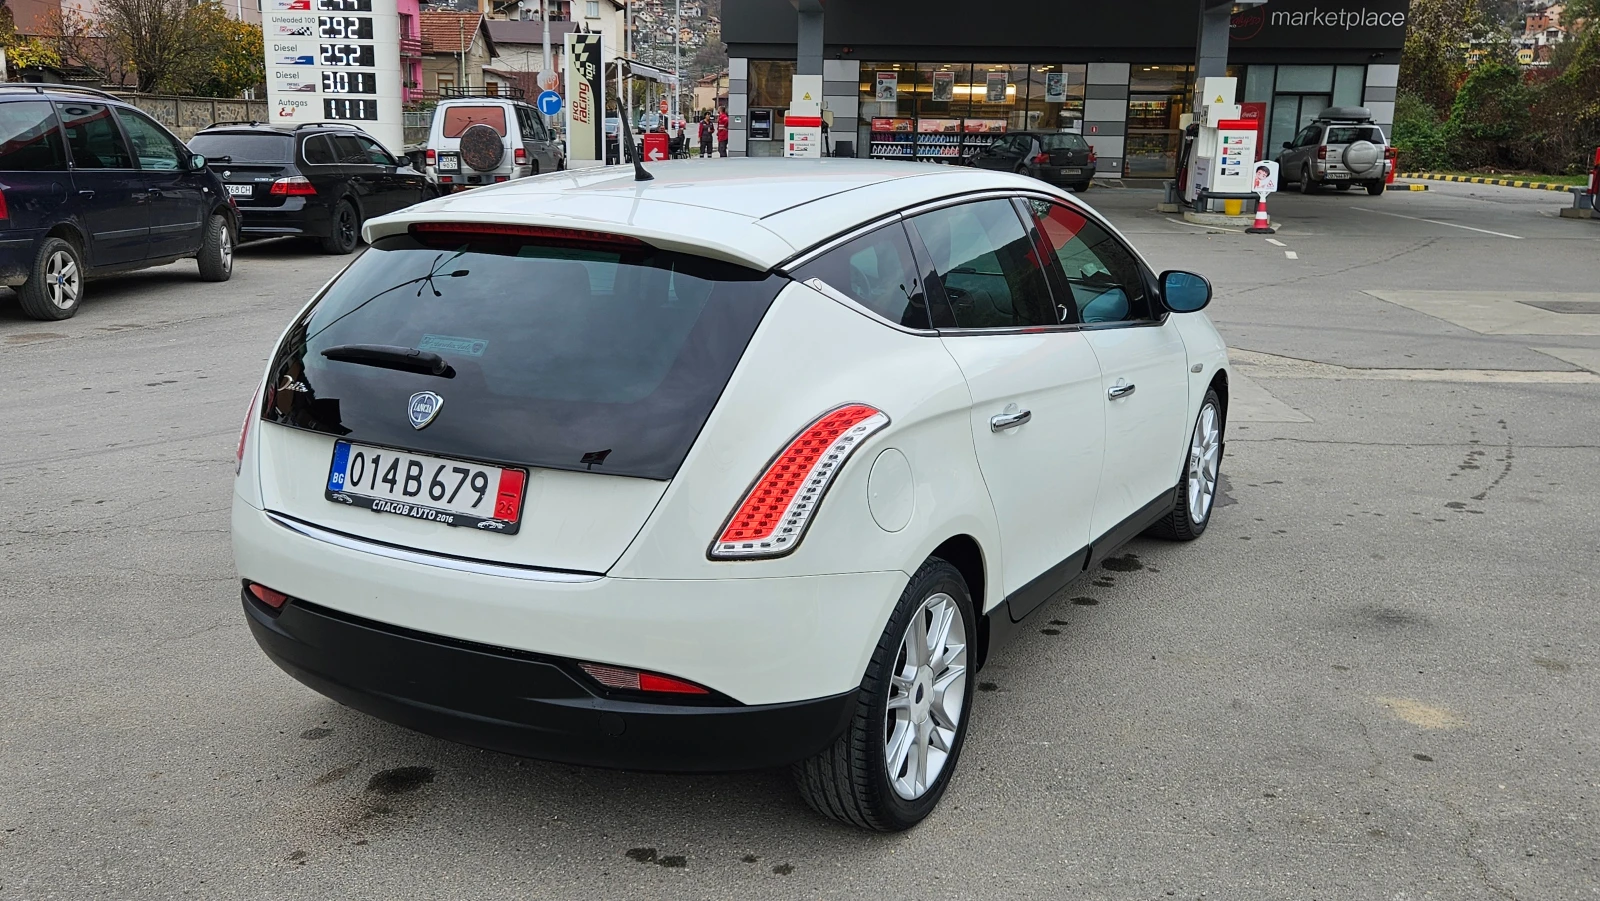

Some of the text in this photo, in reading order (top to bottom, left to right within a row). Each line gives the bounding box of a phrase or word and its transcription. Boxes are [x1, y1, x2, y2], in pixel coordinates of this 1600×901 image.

[319, 16, 359, 38] 2.92
[1271, 7, 1405, 30] marketplace
[274, 44, 298, 52] Diesel
[320, 45, 360, 66] 2.52
[276, 71, 300, 79] Diesel
[585, 62, 593, 80] 100
[323, 72, 363, 92] 3.01
[278, 99, 308, 108] Autogas
[330, 99, 364, 119] 1.11
[579, 82, 590, 124] racing
[413, 402, 432, 414] LANCIA
[332, 472, 344, 485] BG
[372, 499, 454, 524] СПАСОВ АУТО 2016
[497, 500, 514, 516] 26
